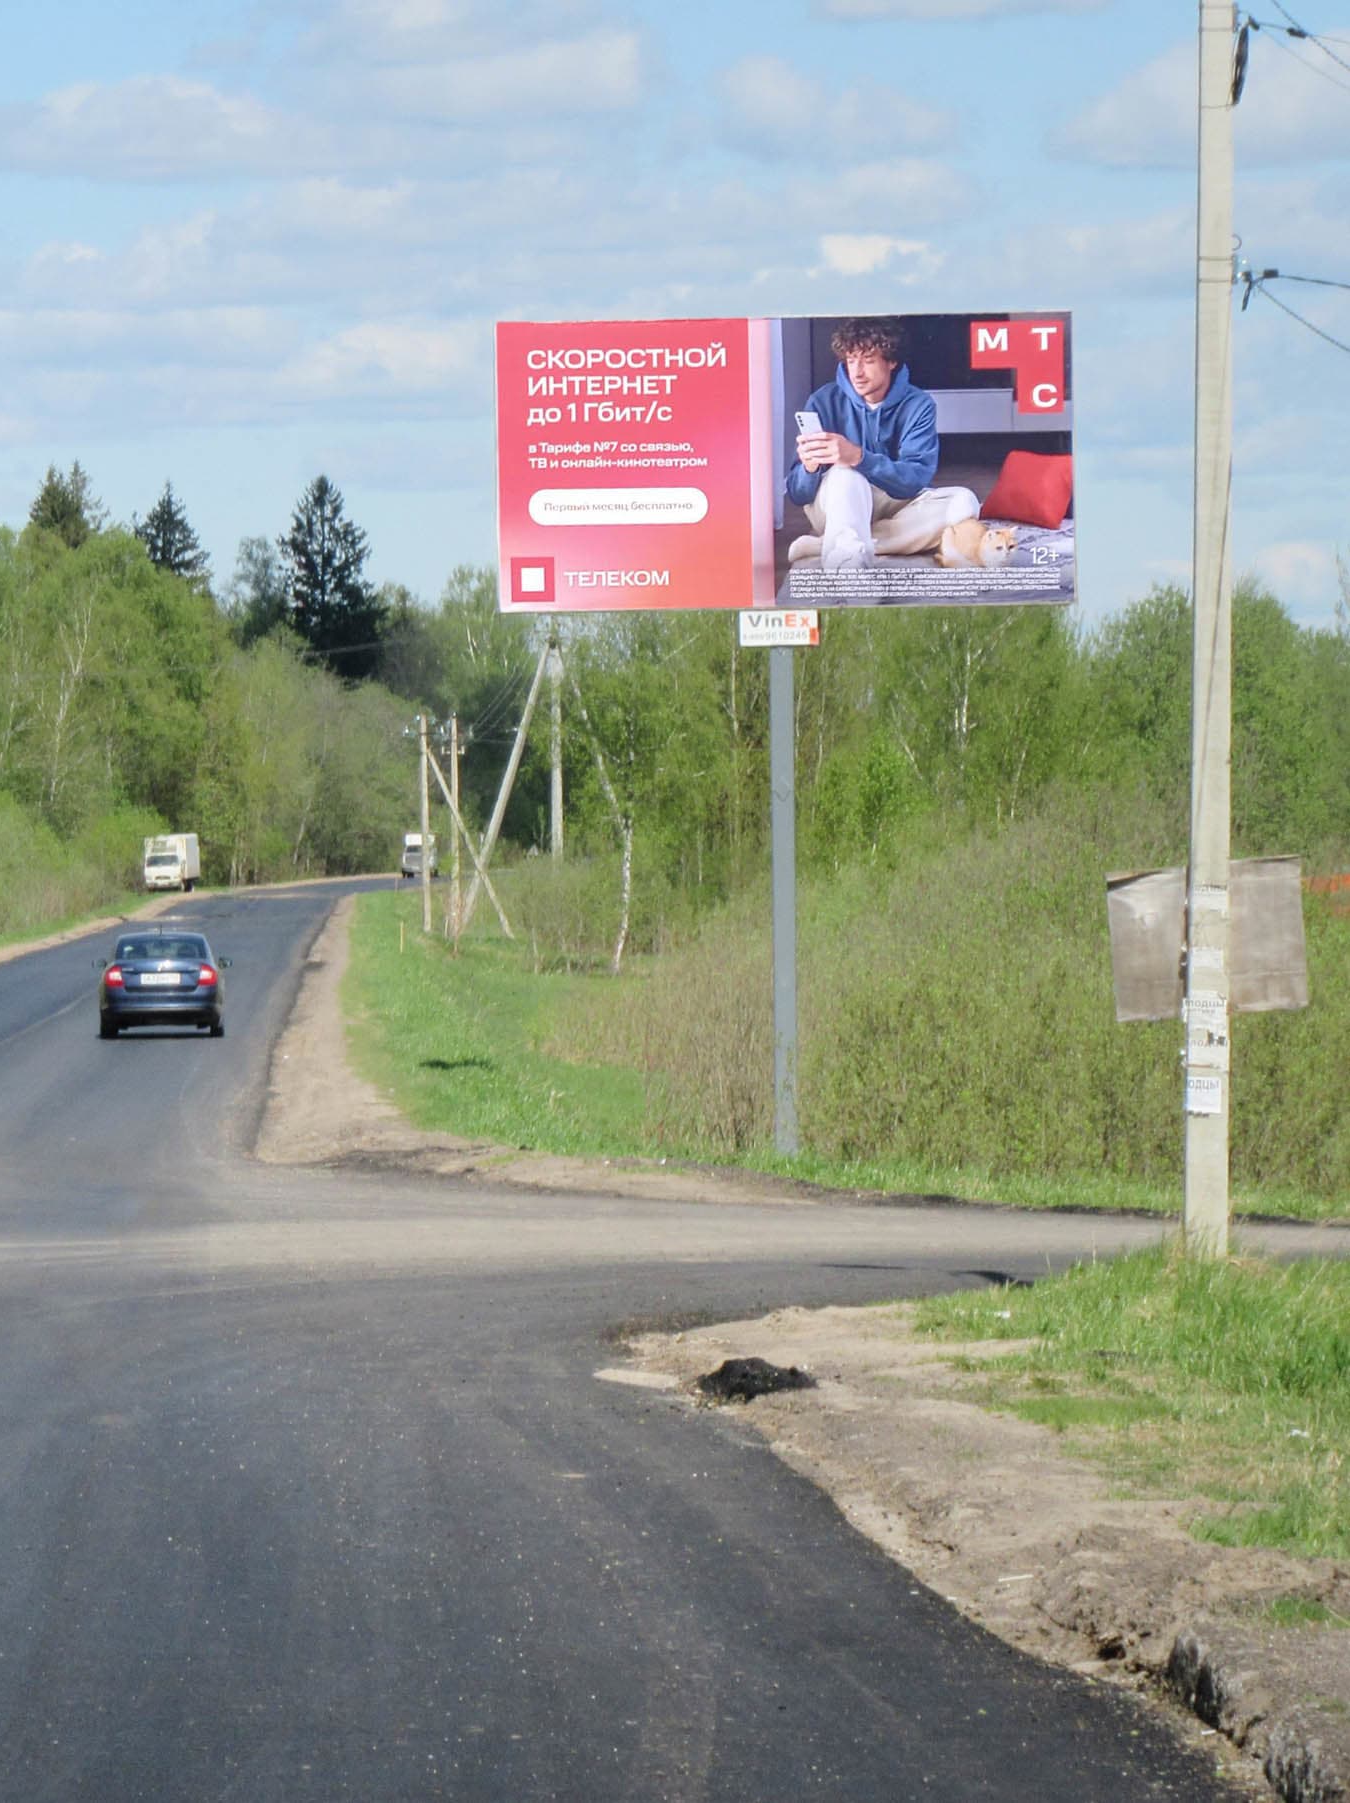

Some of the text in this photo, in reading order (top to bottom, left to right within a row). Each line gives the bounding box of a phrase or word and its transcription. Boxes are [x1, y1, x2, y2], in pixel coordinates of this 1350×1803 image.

[526, 342, 727, 370] СКОРОСТНОЙ
[527, 374, 678, 396] ИНТЕРНЕТ
[526, 401, 673, 426] до 1 Гбит/с
[528, 441, 695, 455] в Тарифе №7 со связью,
[528, 456, 708, 469] ТВ и онлайн-кинотеатром
[544, 500, 694, 513] Первый месяц бесплатно
[1029, 547, 1060, 565] 12+
[563, 569, 671, 588] ТЕЛЕКОМ
